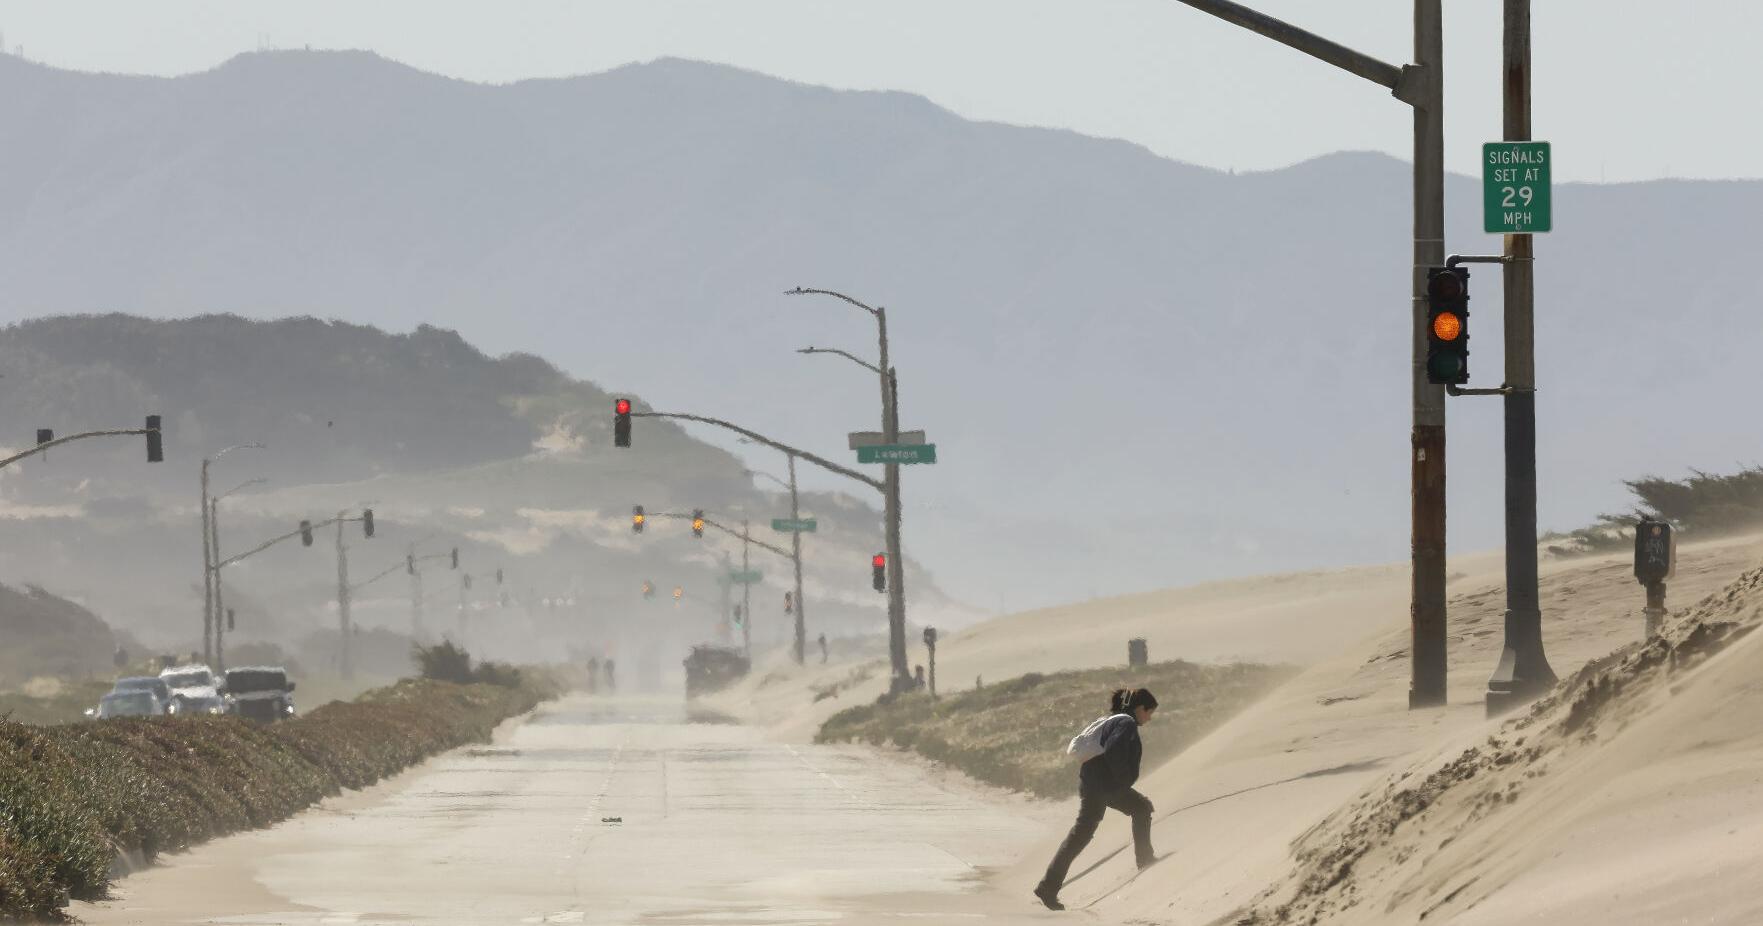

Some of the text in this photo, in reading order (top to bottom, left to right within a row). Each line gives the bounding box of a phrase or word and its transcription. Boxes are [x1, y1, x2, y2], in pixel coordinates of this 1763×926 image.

[1489, 151, 1544, 164] SIGNALS
[1494, 168, 1539, 182] SET AT
[1502, 186, 1533, 207] 29
[1504, 212, 1531, 224] MPH
